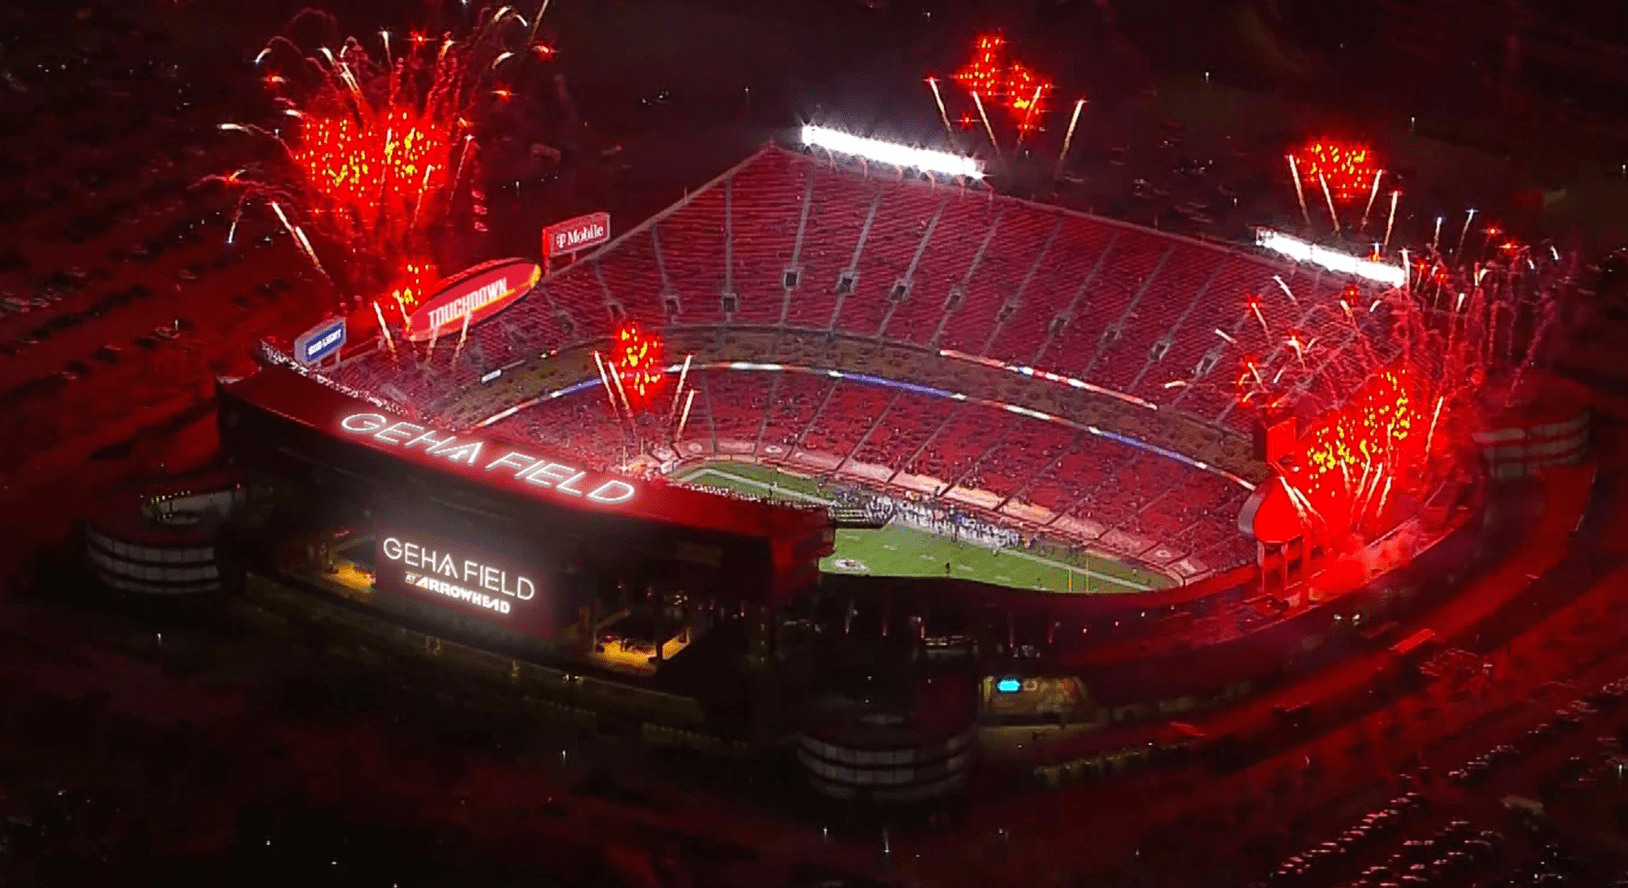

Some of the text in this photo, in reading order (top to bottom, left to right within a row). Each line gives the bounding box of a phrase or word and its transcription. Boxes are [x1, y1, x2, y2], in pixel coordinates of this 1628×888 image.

[428, 277, 507, 329] TOUCHDOWN
[341, 413, 635, 503] GEHA FIELD
[383, 538, 535, 600] GEHA FIELD
[416, 577, 510, 614] ARROWHEAD
